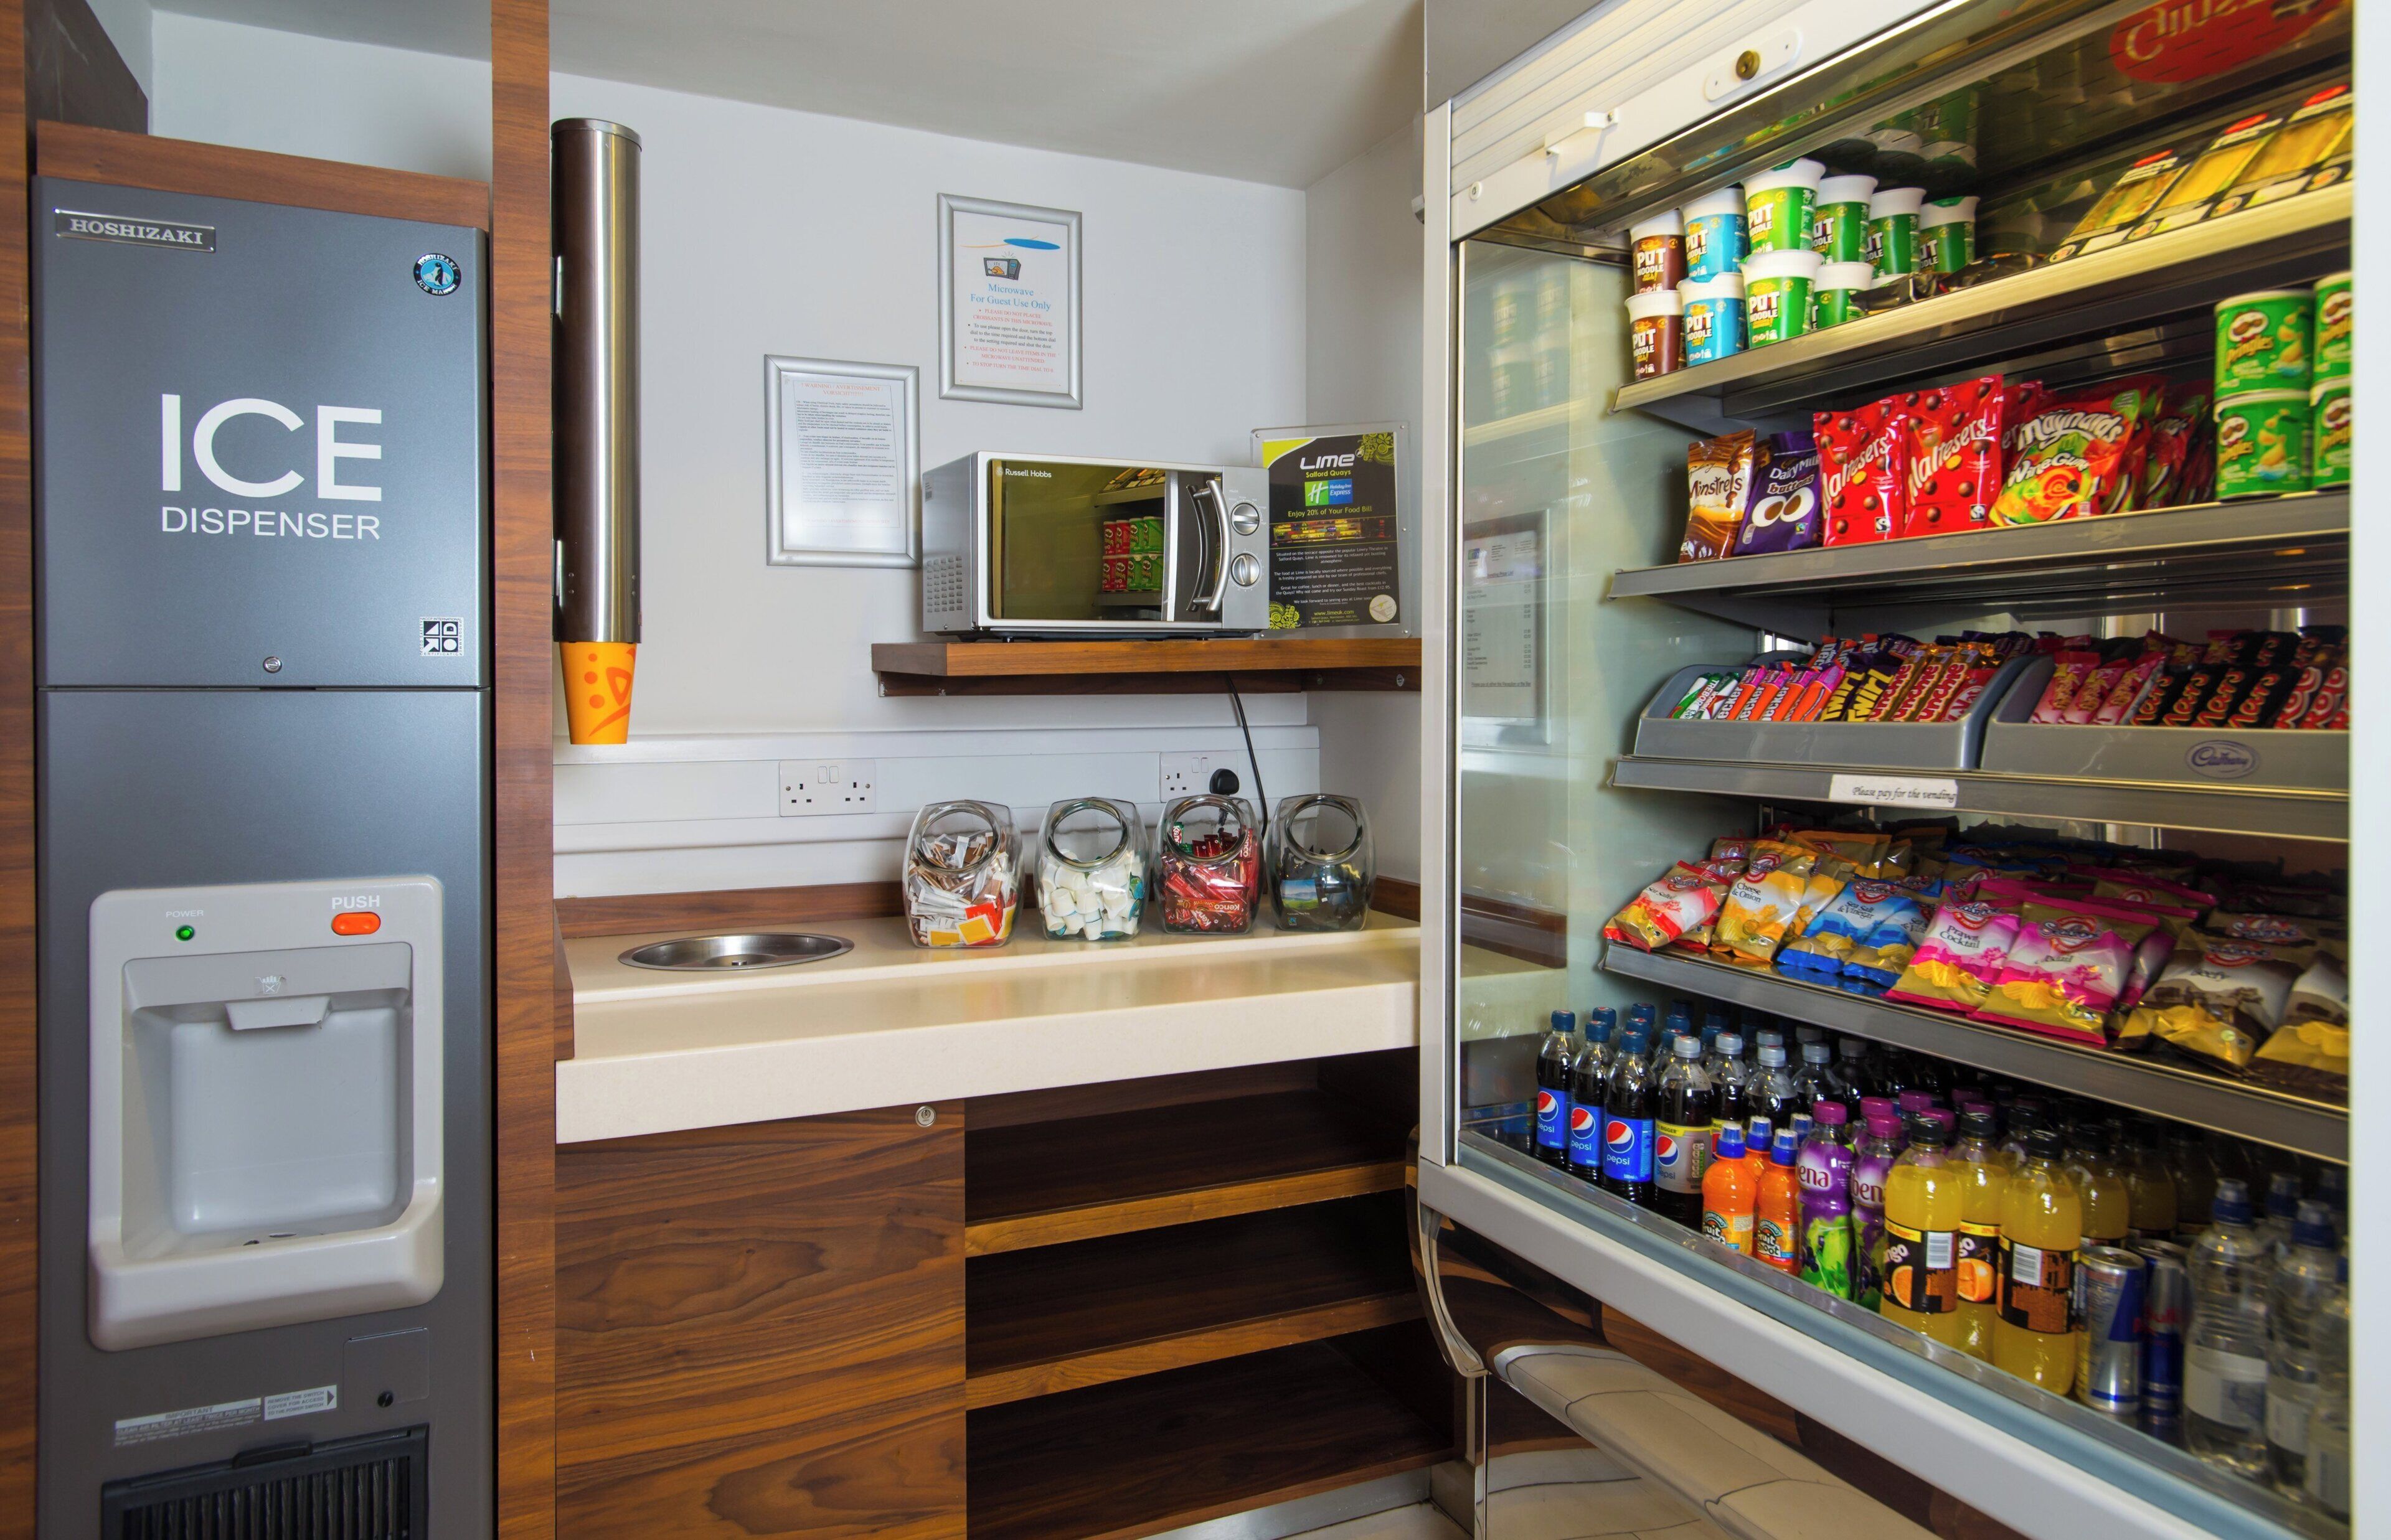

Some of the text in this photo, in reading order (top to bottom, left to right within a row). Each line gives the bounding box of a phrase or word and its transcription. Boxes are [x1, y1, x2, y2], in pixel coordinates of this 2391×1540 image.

[1748, 203, 1774, 229] POT
[70, 218, 204, 245] HOSHIZAKI
[1636, 248, 1667, 268] POT
[1637, 264, 1665, 276] NOODLE
[988, 283, 1034, 296] Microwave
[970, 293, 1051, 312] For Guest Use Only
[1749, 290, 1780, 314] POT
[1686, 311, 1715, 334] POT
[1633, 328, 1656, 351] POT
[981, 353, 1011, 361] MICROWAVE
[162, 394, 382, 502] ICE
[1005, 468, 1052, 478] Russell Hobbs
[1306, 471, 1328, 479] Salford
[1769, 464, 1799, 481] Dairy
[1288, 509, 1305, 519] Enjoy
[1328, 507, 1343, 515] Your
[1345, 505, 1361, 514] Food
[162, 506, 380, 540] DISPENSER
[1695, 678, 1720, 710] TREBOR
[1852, 786, 1956, 804] Please pay for the vending
[1736, 882, 1761, 896] Cheese
[331, 894, 381, 909] PUSH
[1731, 890, 1761, 903] & Onion
[166, 909, 204, 918] POWER
[1214, 903, 1240, 911] Kenco
[1846, 900, 1875, 913] Sea Salt
[1845, 908, 1875, 920] Vinegar
[1940, 931, 1981, 949] Cocktail
[1946, 925, 1980, 941] Prawn
[1571, 1140, 1592, 1152] pepsi
[1606, 1153, 1630, 1167] pepsi
[166, 1406, 214, 1420] IMPORTANT
